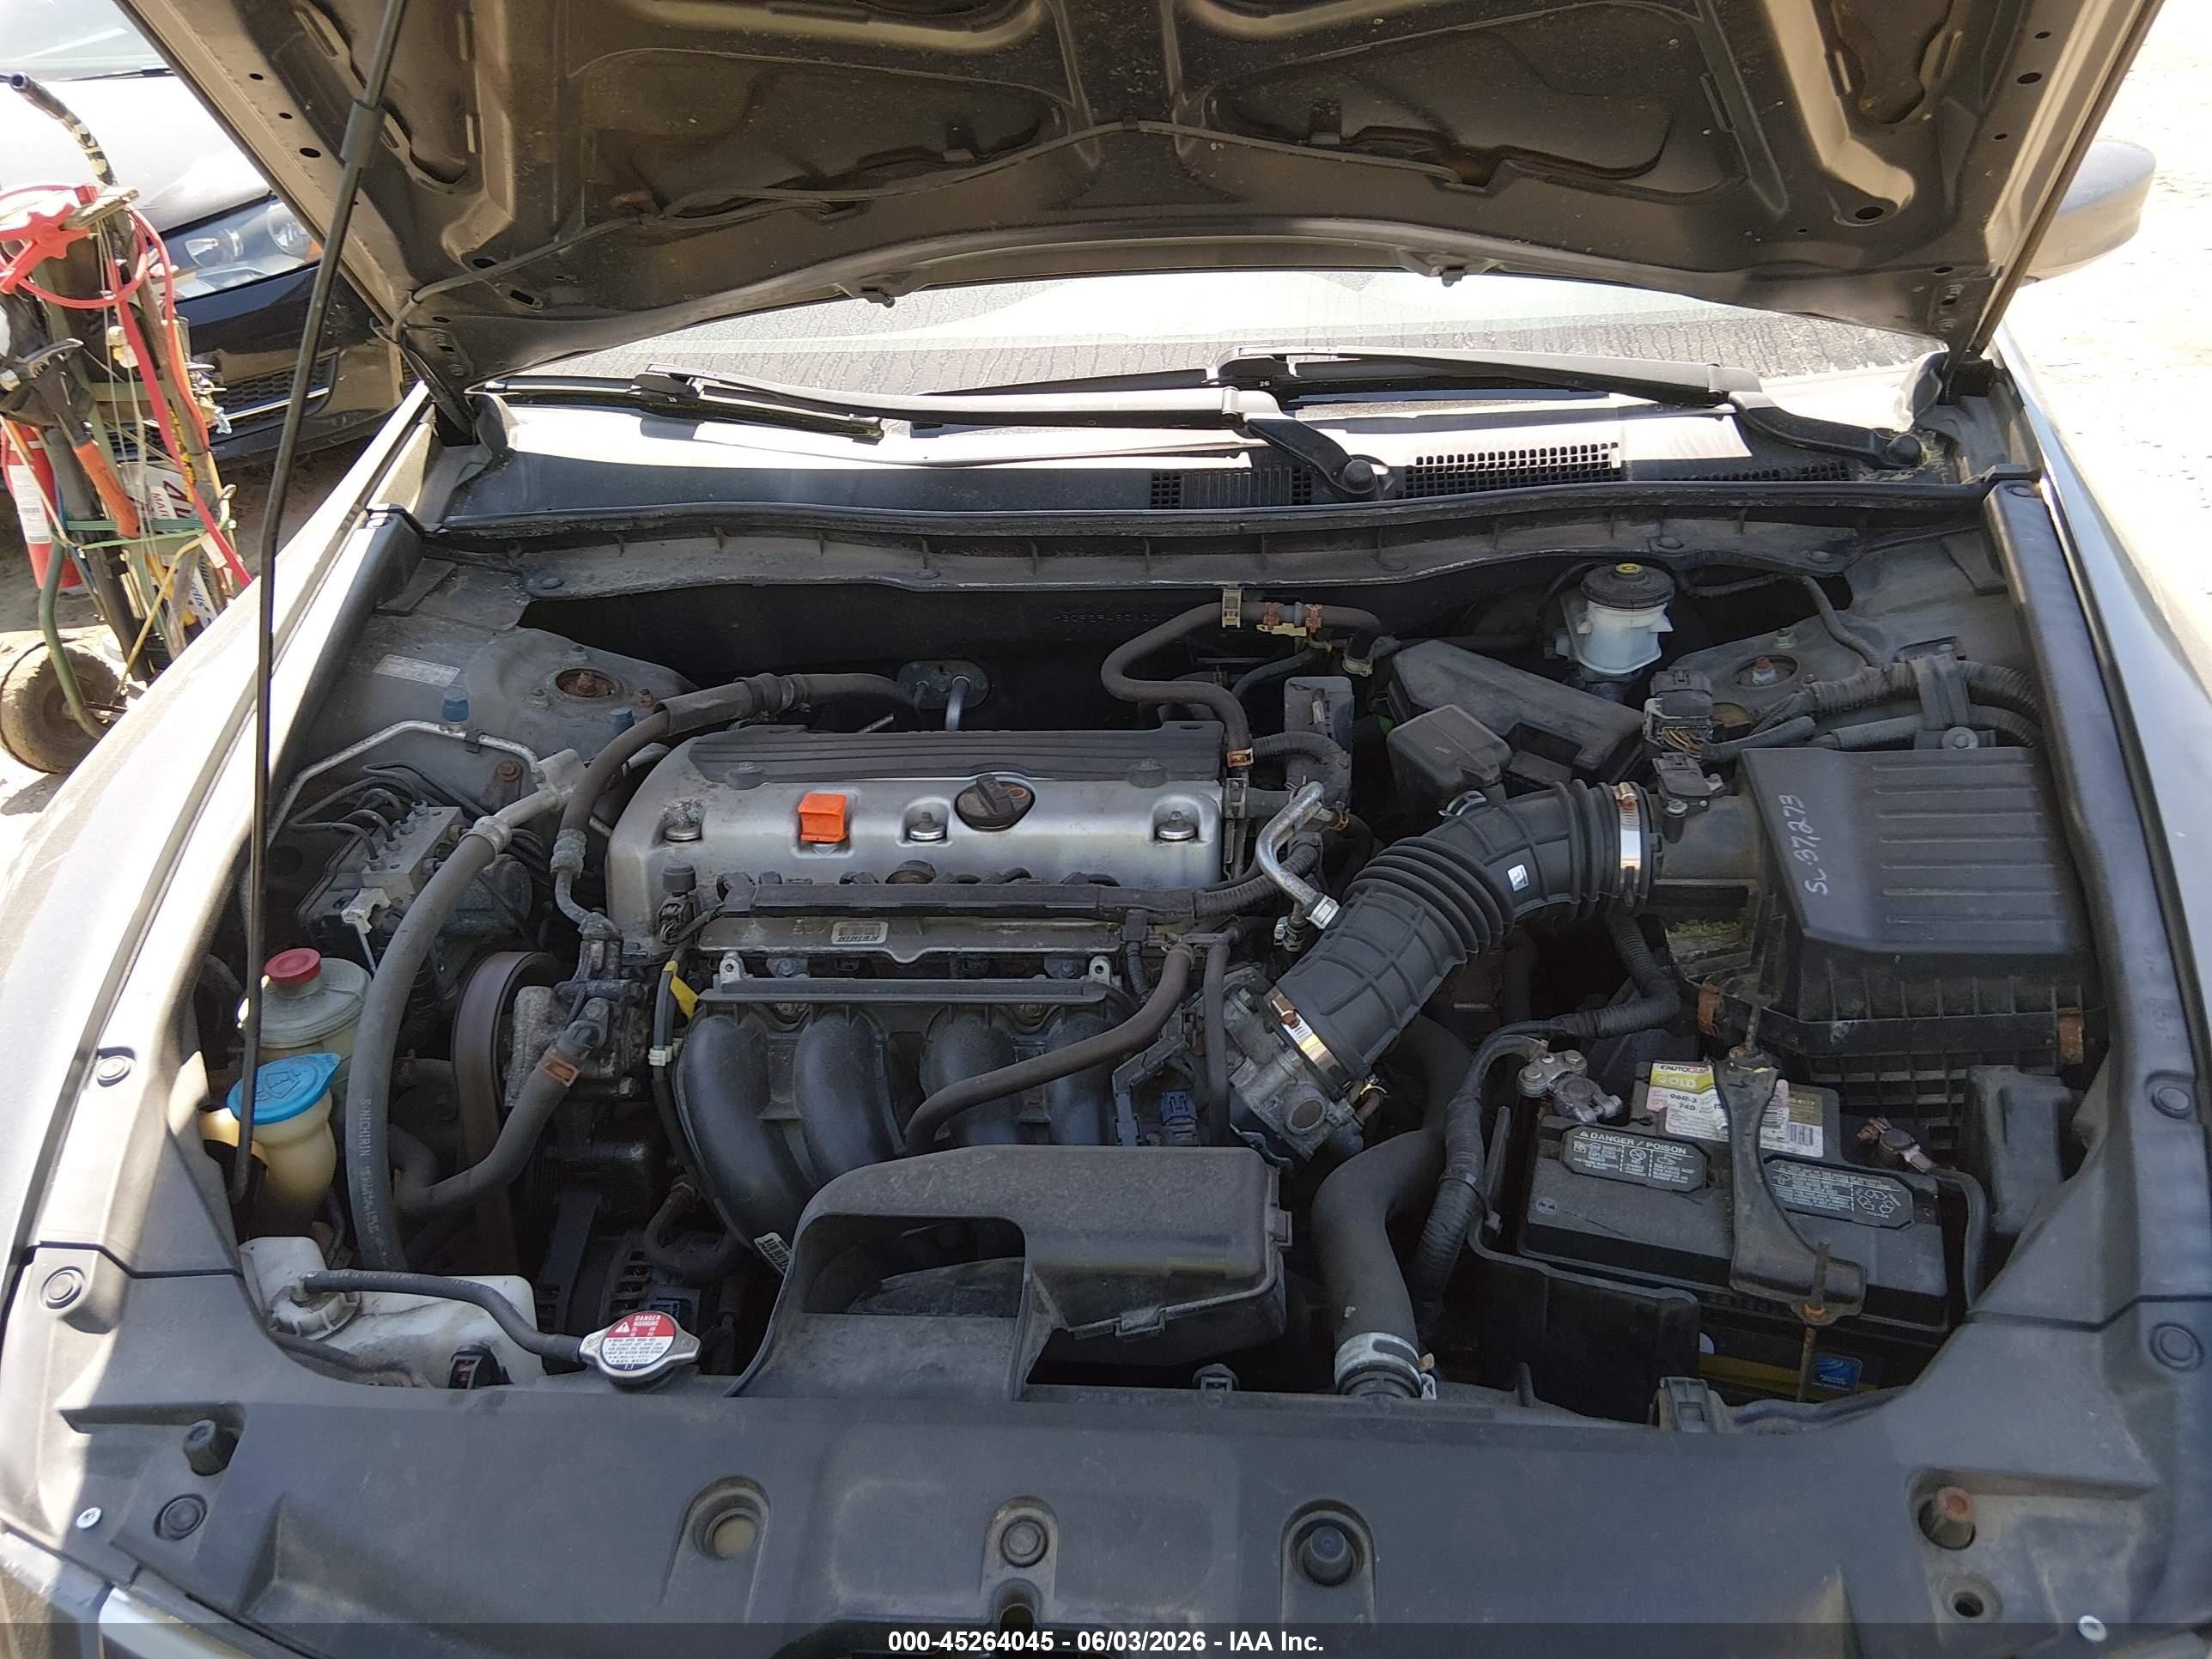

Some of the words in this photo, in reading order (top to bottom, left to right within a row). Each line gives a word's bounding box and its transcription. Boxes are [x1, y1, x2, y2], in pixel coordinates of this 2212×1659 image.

[1657, 1075, 1697, 1088] GOLD
[1590, 1132, 1634, 1146] DANGER
[1646, 1142, 1687, 1155] POISON
